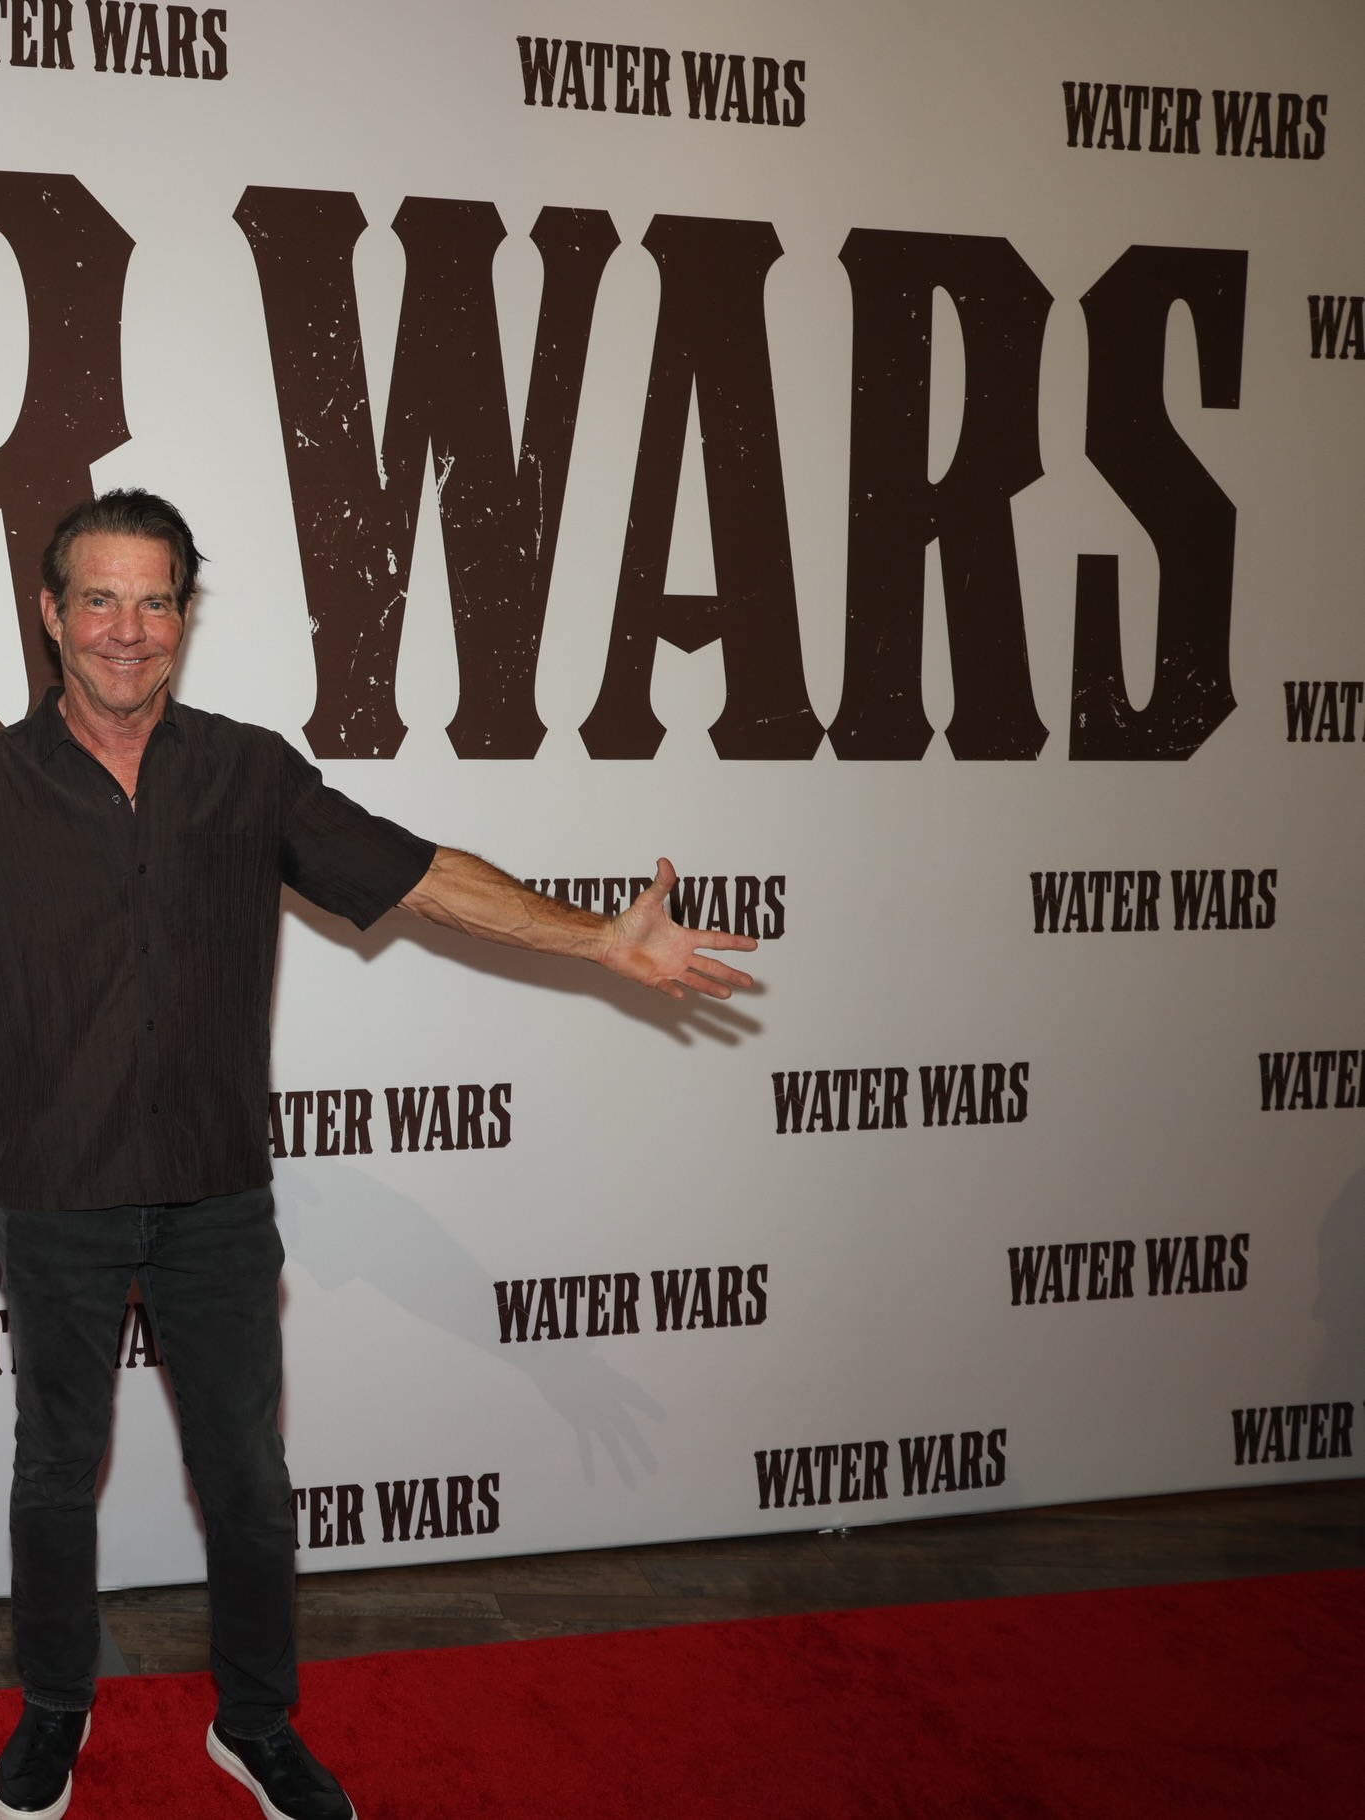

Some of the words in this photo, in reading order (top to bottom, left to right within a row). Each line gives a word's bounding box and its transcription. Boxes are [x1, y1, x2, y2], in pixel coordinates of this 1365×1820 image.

[85, 0, 228, 80] WARS
[516, 36, 671, 117] WATER
[682, 51, 806, 127] WARS
[1062, 81, 1202, 154] WATER
[1212, 90, 1328, 160] WARS
[232, 185, 1249, 761] WARS
[1283, 681, 1365, 743] WAT
[668, 875, 786, 940] WARS
[1030, 871, 1161, 933] WATER
[1171, 869, 1277, 930] WARS
[771, 1067, 909, 1134] WATER
[919, 1062, 1029, 1127] WARS
[1259, 1050, 1365, 1111] WATE
[268, 1089, 373, 1158] ATER
[384, 1083, 511, 1153] WARS
[493, 1273, 640, 1343] WATER
[651, 1264, 768, 1332] WARS
[1008, 1240, 1136, 1306] WATER
[1145, 1233, 1249, 1296] WARS
[754, 1441, 889, 1509] WATER
[899, 1429, 1006, 1496] WARS
[1232, 1402, 1354, 1465] WATER
[375, 1473, 500, 1542] WARS
